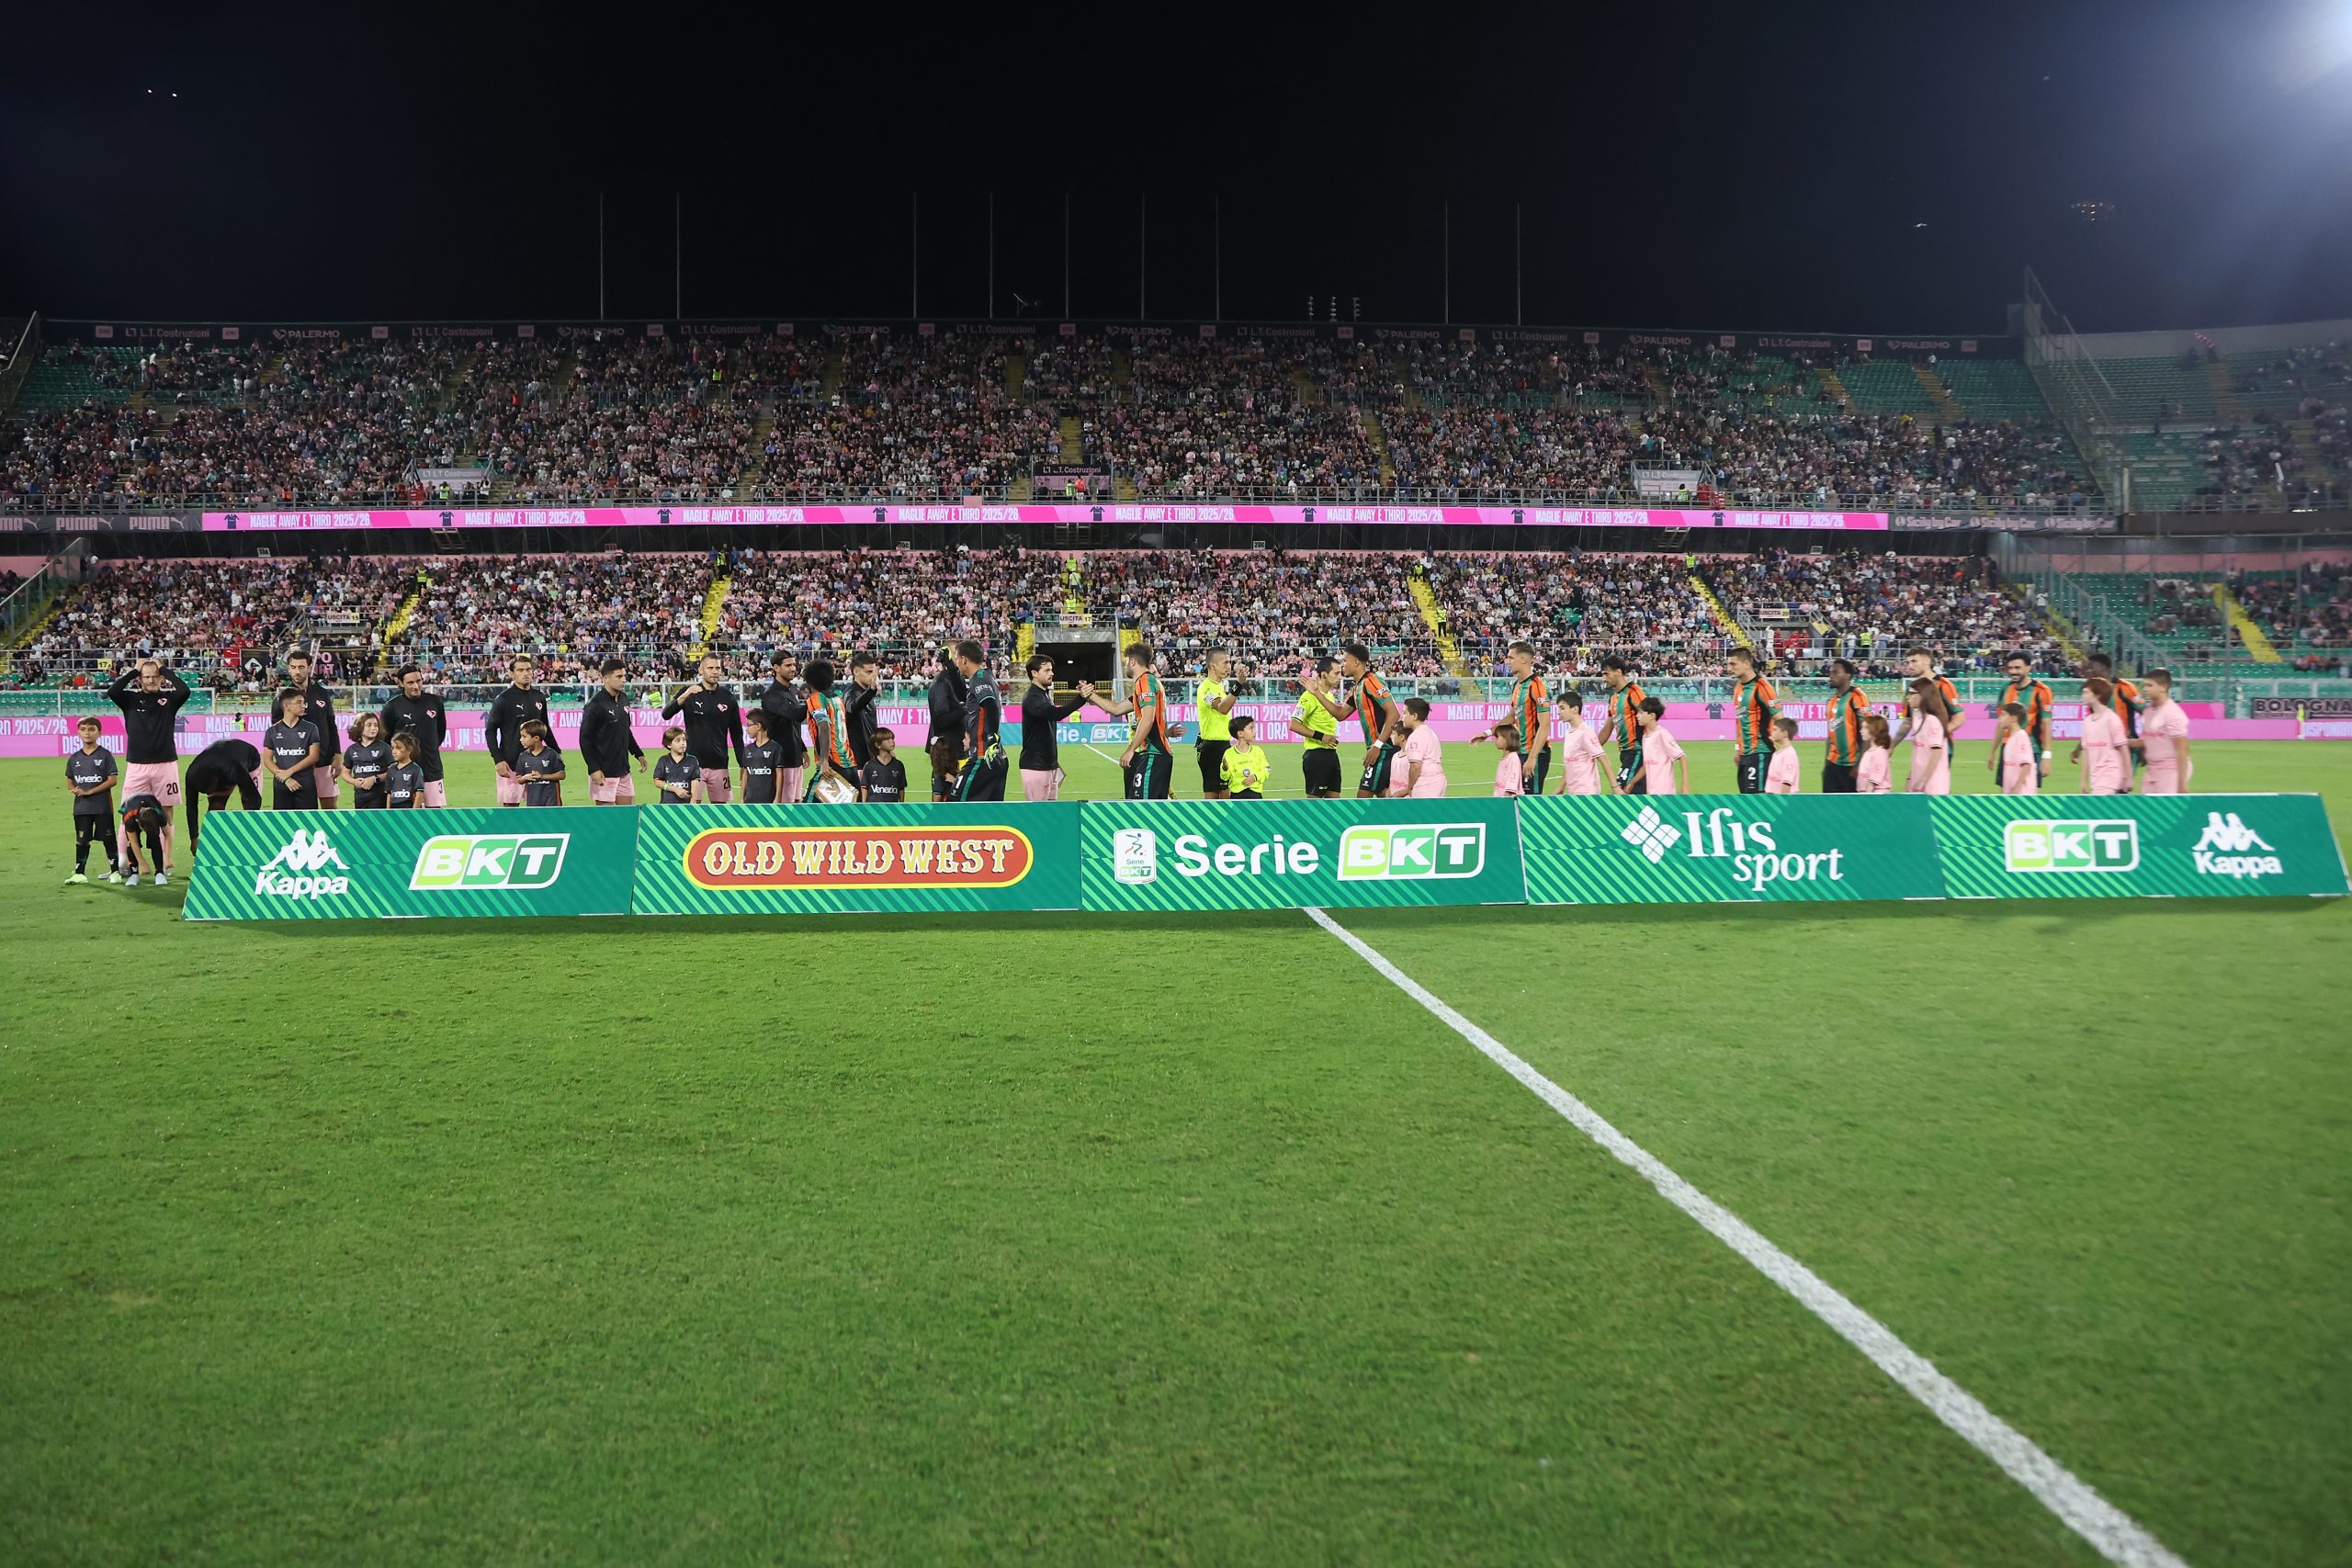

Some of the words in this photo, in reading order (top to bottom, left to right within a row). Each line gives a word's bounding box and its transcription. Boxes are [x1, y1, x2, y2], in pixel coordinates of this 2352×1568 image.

[288, 330, 340, 338] PALERMO
[1120, 327, 1171, 336] PALERMO
[1391, 329, 1441, 338] PALERMO
[1643, 336, 1691, 344] PALERMO
[1901, 341, 1950, 349] PALERMO
[250, 514, 277, 527] MAGLIE
[278, 514, 300, 527] AWAY
[303, 514, 307, 527] E
[310, 514, 331, 527] THIRD
[334, 513, 370, 526] 2025/26
[465, 512, 491, 525] MAGLIE
[493, 512, 515, 525] AWAY
[518, 512, 522, 525] E
[524, 511, 546, 524] THIRD
[548, 511, 585, 524] 2025/26
[684, 510, 709, 522] MAGLIE
[711, 510, 733, 522] AWAY
[735, 510, 741, 522] E
[742, 509, 764, 522] THIRD
[766, 509, 803, 522] 2025/26
[899, 508, 925, 521] MAGLIE
[927, 508, 949, 521] AWAY
[952, 508, 956, 521] E
[957, 508, 979, 521] THIRD
[982, 508, 1018, 521] 2025/26
[1115, 507, 1141, 520] MAGLIE
[1143, 507, 1165, 520] AWAY
[1167, 507, 1172, 520] E
[1174, 507, 1196, 520] THIRD
[1198, 507, 1234, 520] 2025/26
[1327, 509, 1352, 522] MAGLIE
[1354, 509, 1376, 522] AWAY
[1378, 509, 1382, 522] E
[1385, 509, 1406, 522] THIRD
[1408, 509, 1442, 522] 2025/26
[1536, 511, 1560, 523] MAGLIE
[1562, 511, 1582, 524] AWAY
[1585, 511, 1589, 524] E
[1591, 511, 1611, 524] THIRD
[1613, 511, 1648, 524] 2025/26
[1735, 513, 1759, 525] MAGLIE
[1761, 514, 1781, 525] AWAY
[1790, 514, 1808, 525] THIRD
[1810, 514, 1844, 527] 2025/26
[0, 517, 22, 530] MA
[56, 516, 98, 531] PUMA
[129, 516, 171, 530] PUMA
[248, 716, 272, 732] AWA
[560, 713, 583, 728] AWA
[276, 747, 306, 756] Venezia
[74, 774, 103, 784] Venezia
[166, 783, 178, 795] 20
[871, 784, 899, 794] Venezia
[1681, 807, 1776, 857] Ifis
[2010, 829, 2131, 862] BKT
[420, 844, 559, 879] BKT
[703, 840, 785, 875] OLD
[790, 840, 894, 875] WILD
[899, 839, 1014, 874] WEST
[1174, 834, 1319, 876] Serie
[1345, 834, 1477, 870] BKT
[1121, 867, 1150, 876] BKT
[1733, 848, 1843, 891] sport
[2192, 852, 2282, 879] Kappa
[254, 871, 349, 899] Kappa
